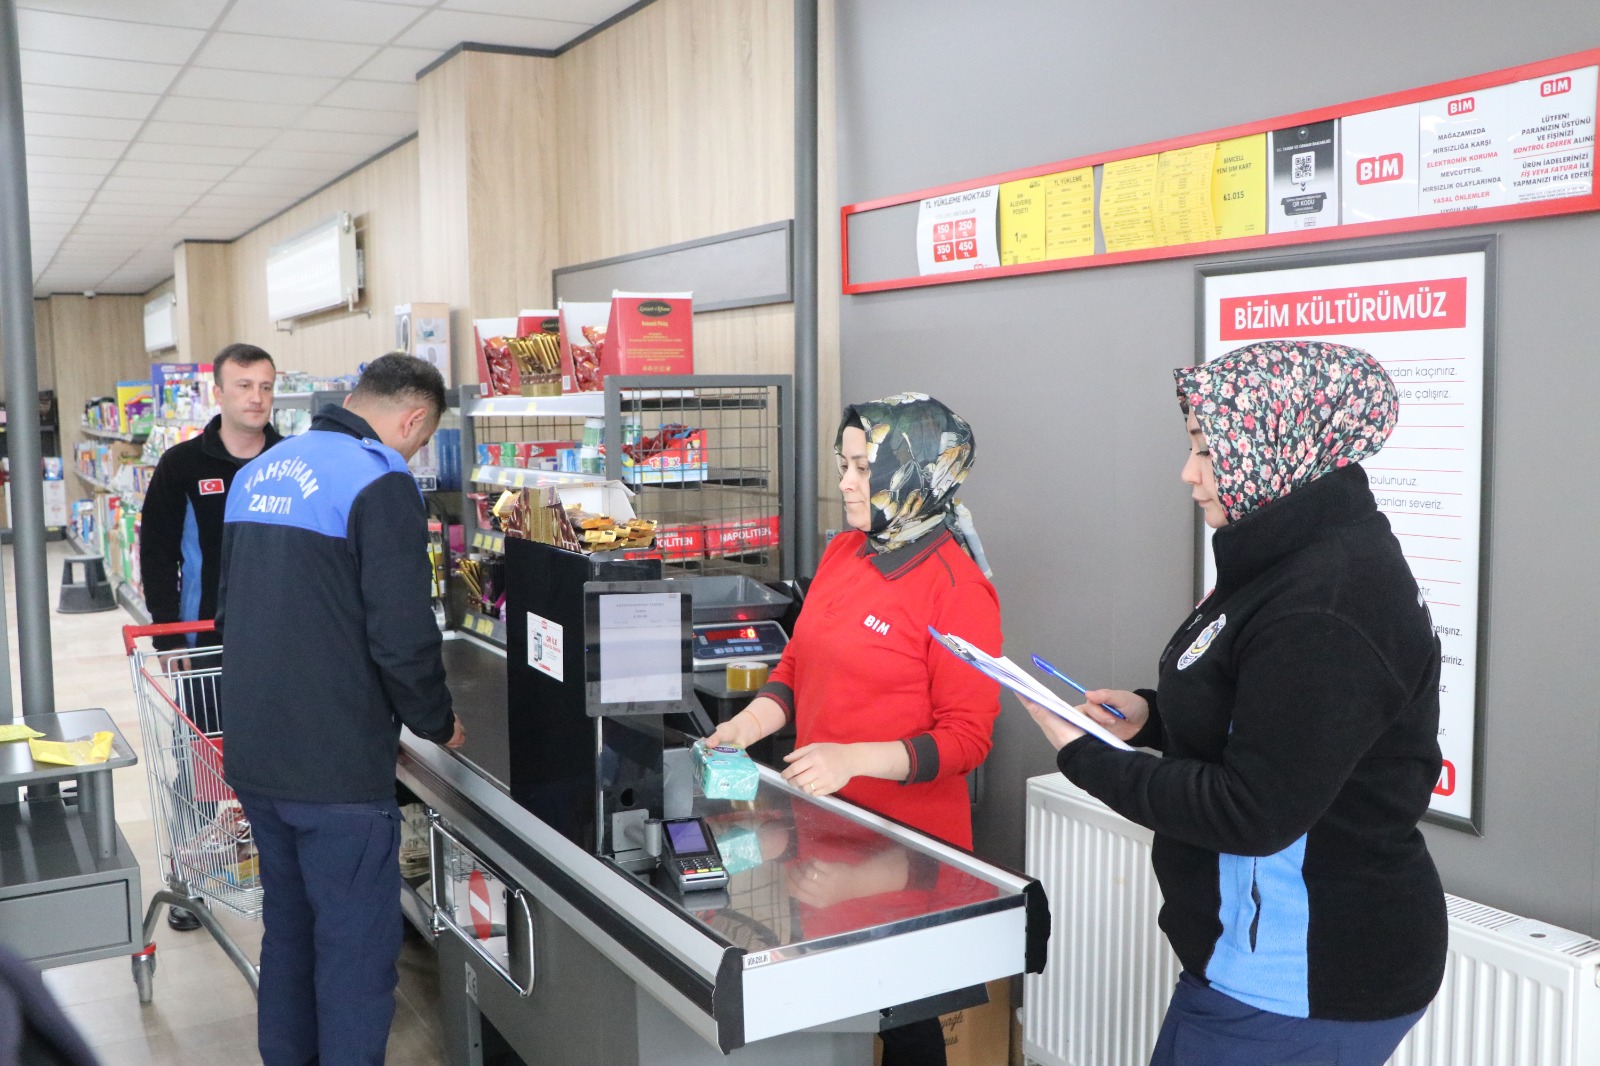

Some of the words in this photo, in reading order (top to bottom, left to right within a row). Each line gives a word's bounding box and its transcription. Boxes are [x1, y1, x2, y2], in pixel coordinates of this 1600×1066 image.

[1543, 79, 1569, 95] BİM
[1450, 99, 1473, 114] BİM
[1542, 112, 1570, 123] LÜTFEN!
[1522, 124, 1560, 135] PARANIZIN
[1561, 117, 1591, 128] ÜSTÜNÜ
[1438, 127, 1486, 141] MAĞAZAMIZDA
[1546, 129, 1574, 140] FİŞİNİZİ
[1433, 143, 1469, 154] HIRSIZLIĞA
[1470, 139, 1491, 148] KARŞI
[1513, 144, 1544, 154] KONTROL
[1546, 139, 1572, 148] EDEREK
[1427, 156, 1467, 168] ELEKTRONİK
[1469, 152, 1498, 161] KORUMA
[1522, 160, 1541, 169] ÜRÜN
[1543, 152, 1589, 166] İADELERİNİZİ
[1217, 166, 1228, 174] YENİ
[1520, 168, 1531, 178] FİŞ
[1532, 167, 1549, 176] VEYA
[1550, 163, 1578, 173] FATURA
[1423, 182, 1454, 192] HIRSIZLIK
[1456, 176, 1501, 188] OLAYLARINDA
[1513, 177, 1551, 188] YAPMANIZI
[1553, 173, 1568, 182] RİCA
[933, 196, 961, 207] YÜKLEME
[963, 190, 991, 201] NOKTASI
[1454, 191, 1490, 201] ÖNLEMLER
[937, 224, 950, 234] 150
[959, 220, 973, 231] 250
[937, 245, 951, 254] 350
[959, 241, 973, 251] 450
[1234, 300, 1289, 330] BİZİM
[1296, 287, 1447, 326] KÜLTÜRÜMÜZ
[244, 456, 319, 499] YAHŞİHAN
[248, 494, 292, 514] ZABITA
